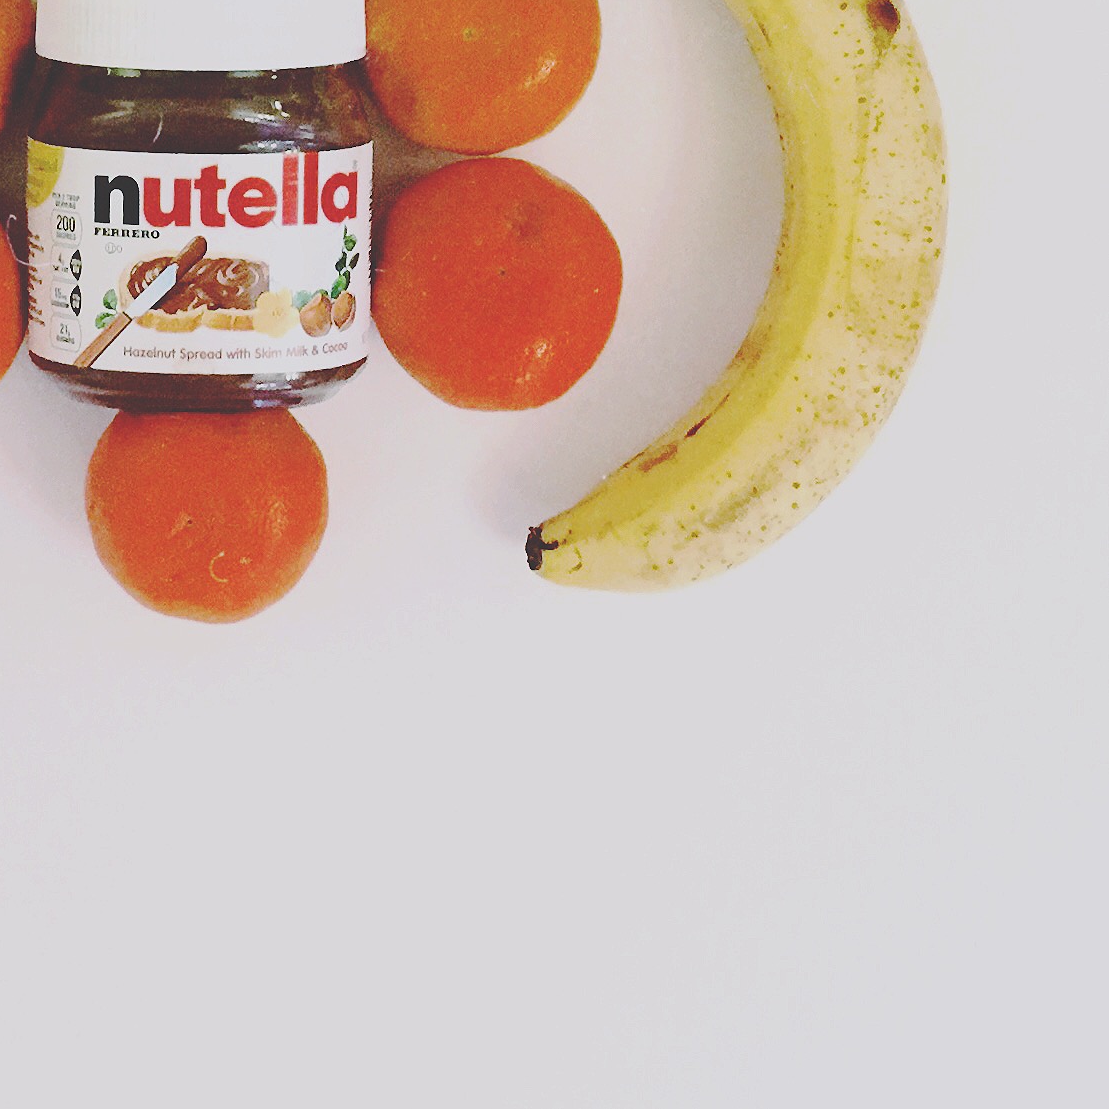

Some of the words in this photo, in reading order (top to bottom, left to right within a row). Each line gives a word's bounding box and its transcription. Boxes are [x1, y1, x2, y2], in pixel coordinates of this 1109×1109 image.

[94, 150, 359, 228] nutella
[56, 214, 76, 233] 200
[94, 226, 160, 239] FERRERO
[122, 345, 177, 359] Hazelnut
[179, 347, 223, 362] Spread
[225, 346, 251, 360] with
[254, 346, 282, 360] Skim
[285, 344, 308, 358] Milk
[311, 343, 319, 355] &
[322, 340, 349, 354] Cocoa
